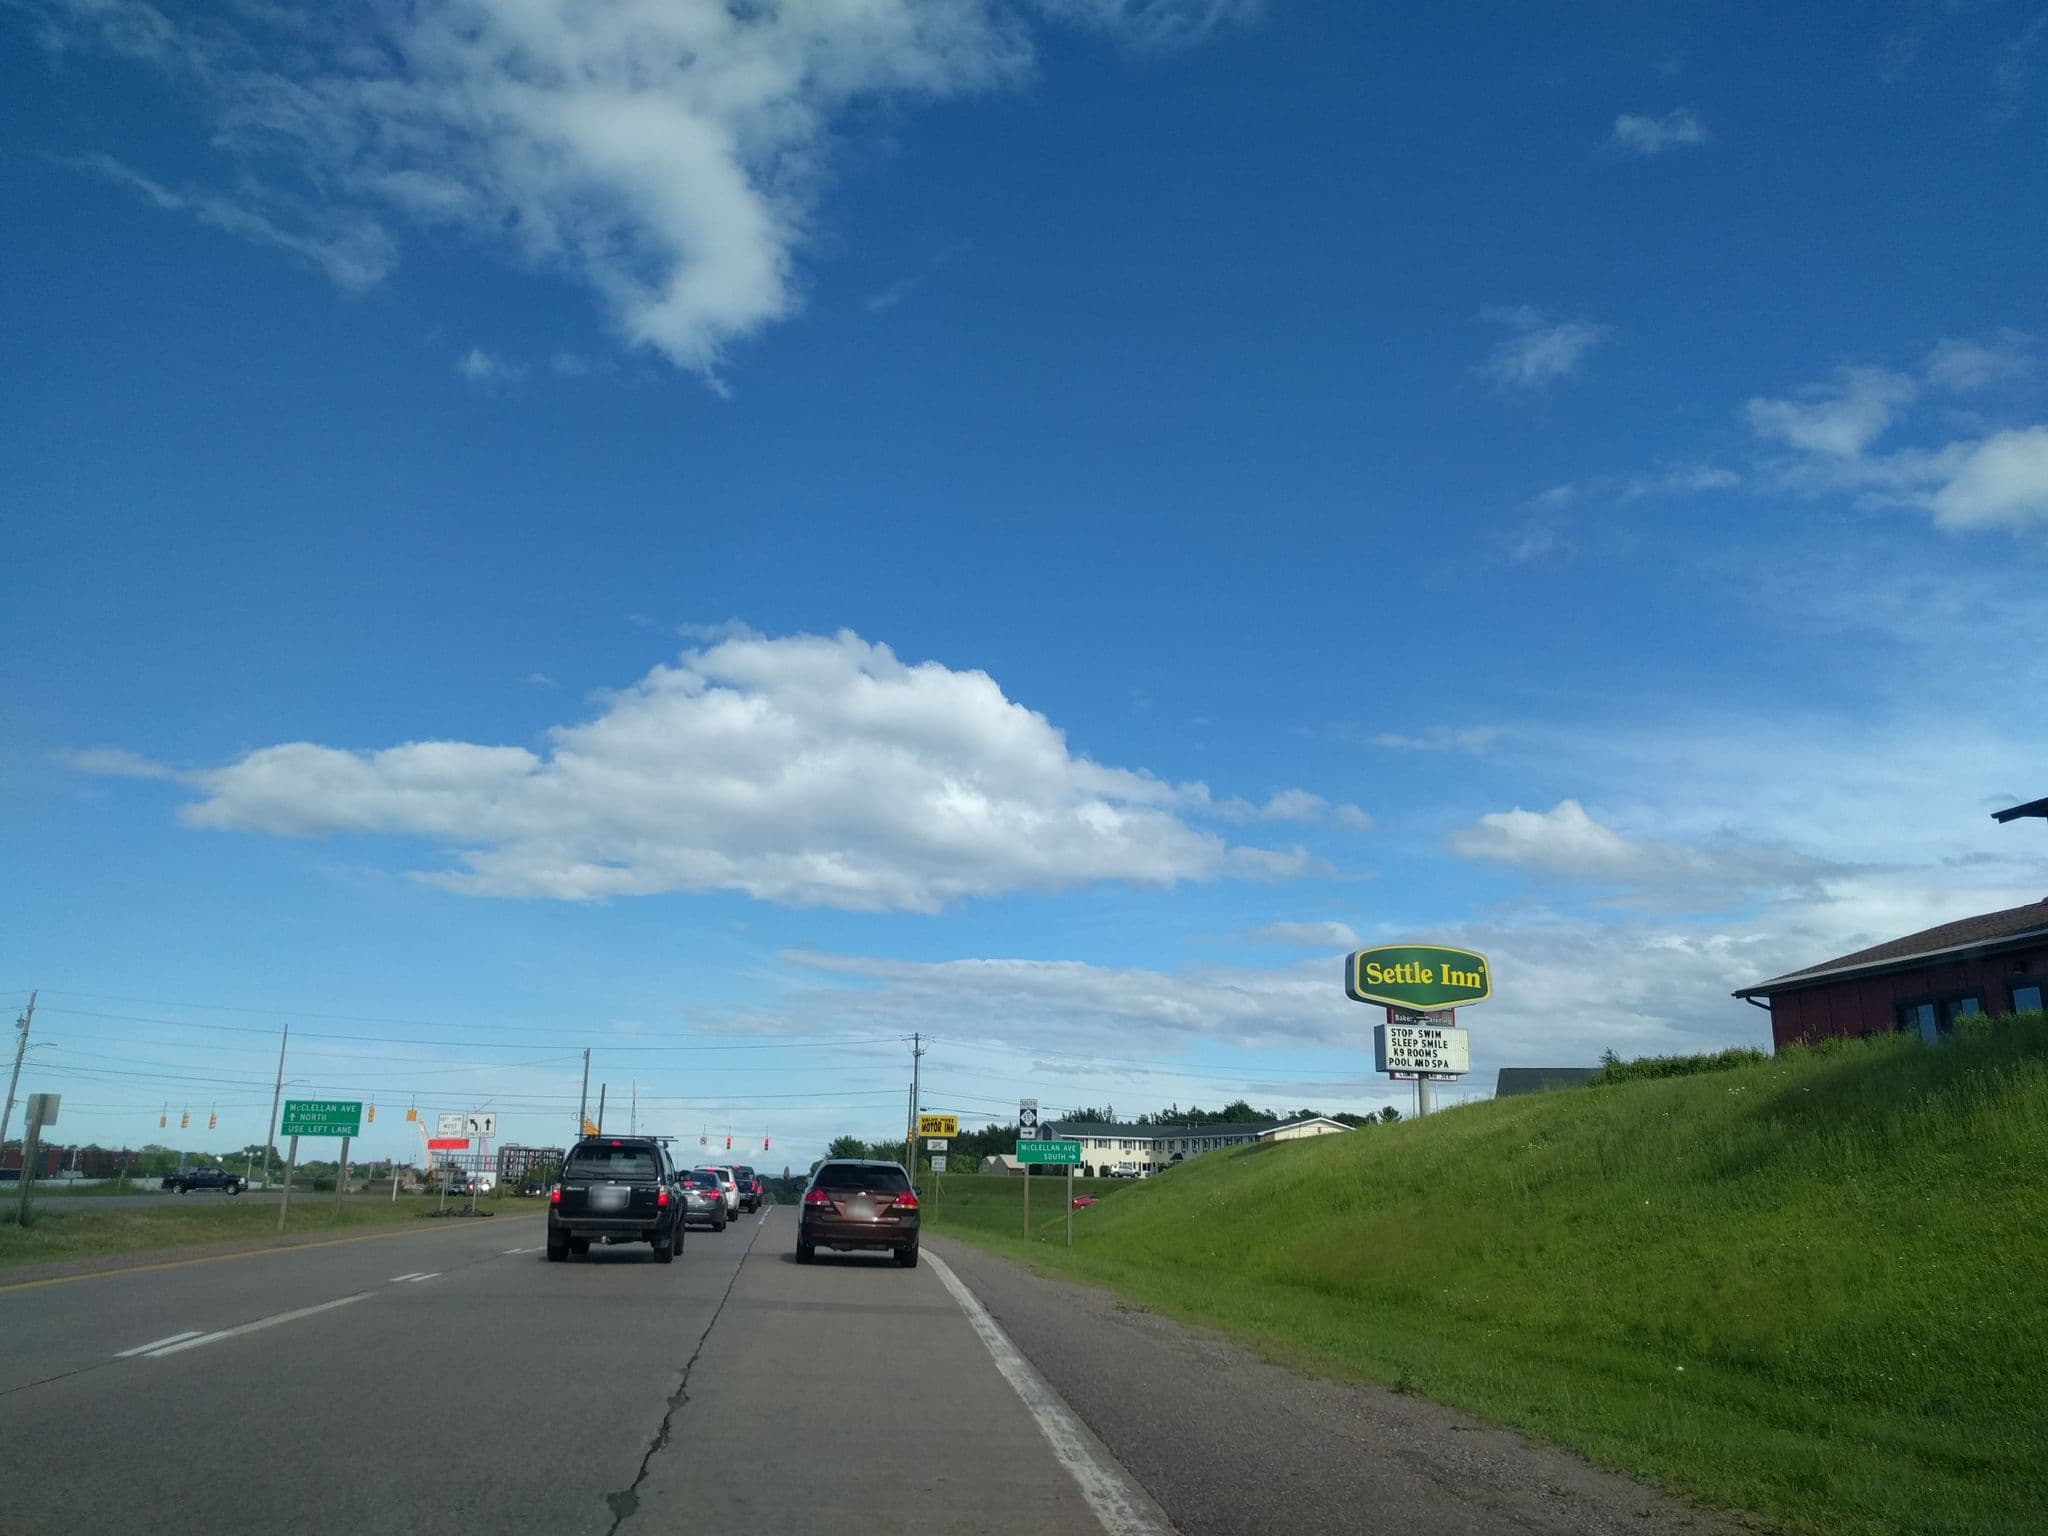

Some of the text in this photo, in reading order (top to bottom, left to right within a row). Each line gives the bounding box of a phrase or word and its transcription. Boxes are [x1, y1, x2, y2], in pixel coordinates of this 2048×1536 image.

[1366, 961, 1481, 988] Settle Inn
[1391, 1028, 1442, 1039] STOP SWIM
[1392, 1038, 1448, 1049] SLEEP SMILE
[1393, 1048, 1438, 1058] K9 ROOMS
[1389, 1057, 1449, 1069] POOL AND SPA
[289, 1103, 337, 1112] McCLELLAN
[299, 1113, 327, 1121] NORTH
[288, 1125, 352, 1134] USE LEFT LANE
[921, 1122, 955, 1133] MOTOR INN
[1021, 1143, 1076, 1152] McCLELLAN AVE
[1043, 1153, 1066, 1161] SOUTH
